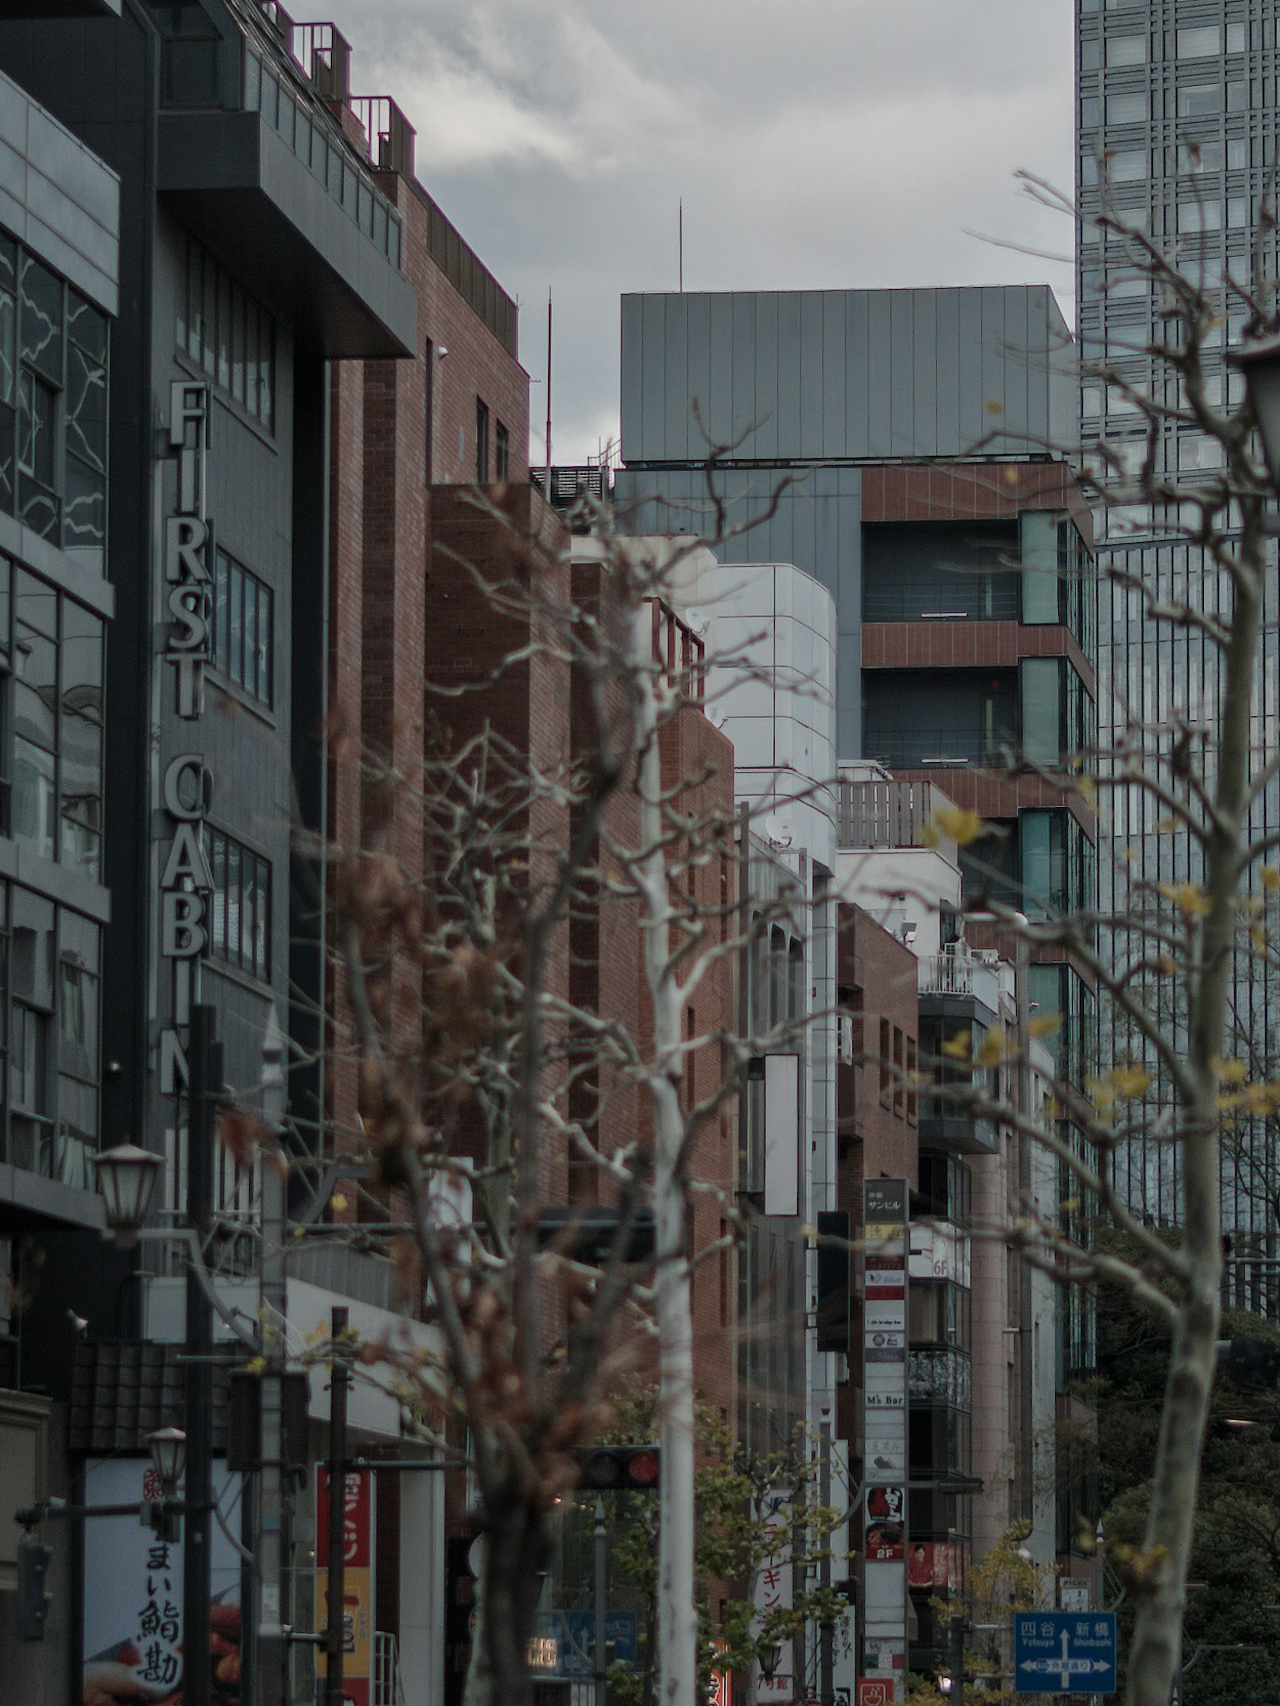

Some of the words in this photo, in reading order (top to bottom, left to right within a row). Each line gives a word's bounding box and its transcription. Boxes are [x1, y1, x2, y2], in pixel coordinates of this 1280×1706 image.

[165, 380, 211, 721] FIRST
[885, 1395, 904, 1405] Bar
[876, 1548, 894, 1559] 2F
[136, 1536, 180, 1685] まい鮨勘
[1021, 1621, 1056, 1637] 四谷
[1075, 1622, 1109, 1638] 新橋
[1022, 1638, 1055, 1648] Yotsuya
[1072, 1638, 1112, 1647] Shinbashi
